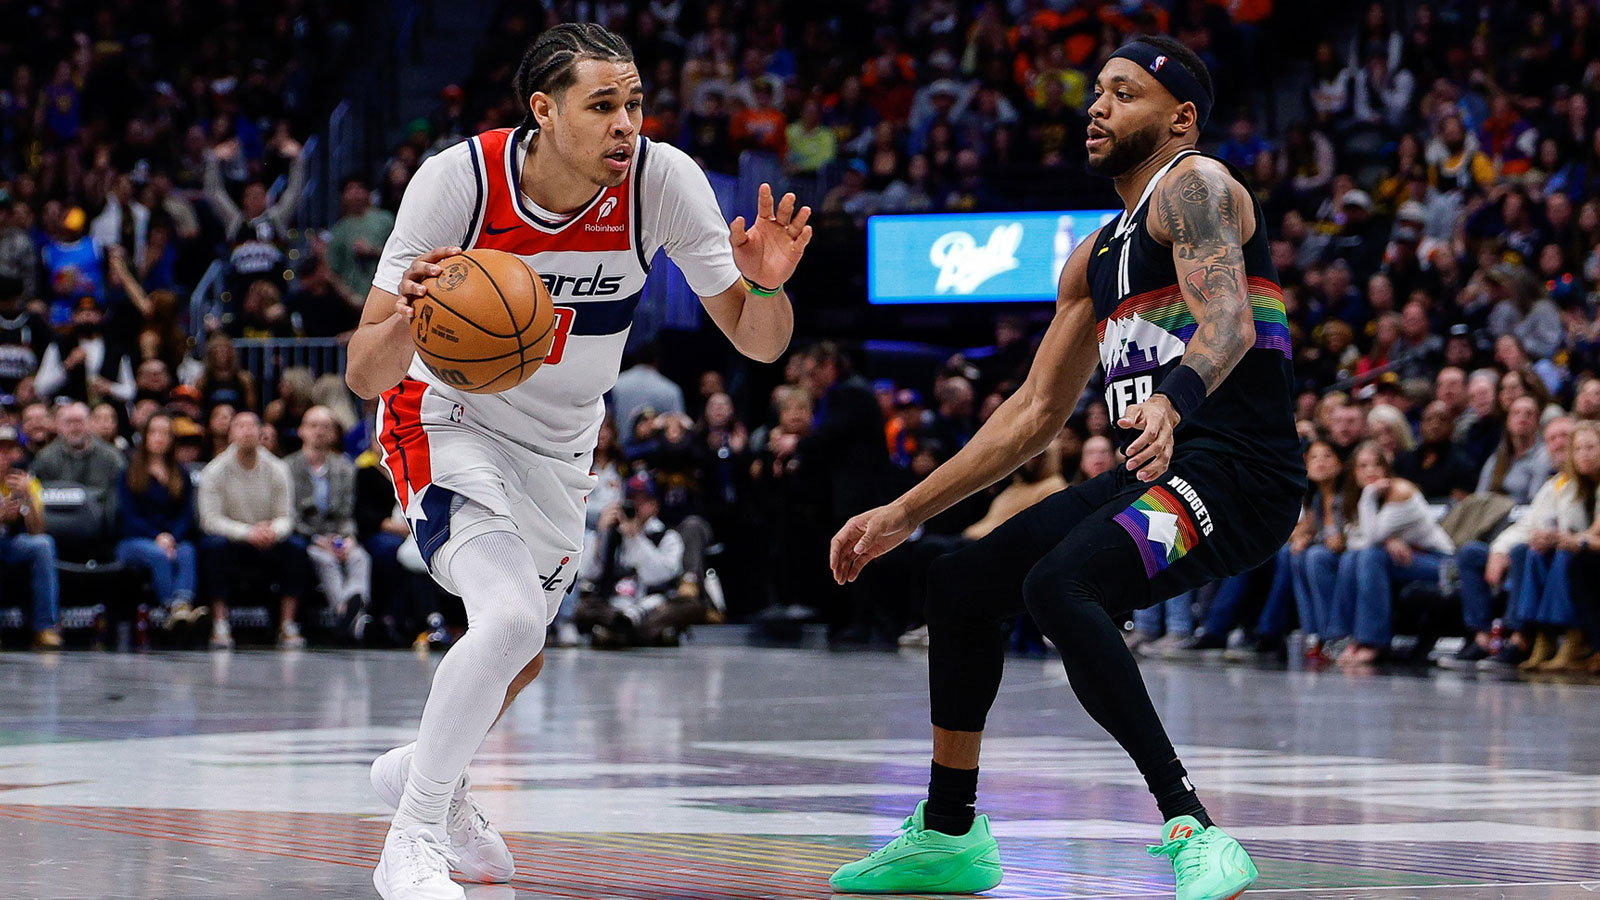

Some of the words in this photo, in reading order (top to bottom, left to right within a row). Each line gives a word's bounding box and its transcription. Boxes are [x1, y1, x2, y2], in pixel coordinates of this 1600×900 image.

[584, 223, 625, 232] Robinhood
[929, 221, 1024, 294] Ball
[1166, 475, 1214, 537] NUGGETS
